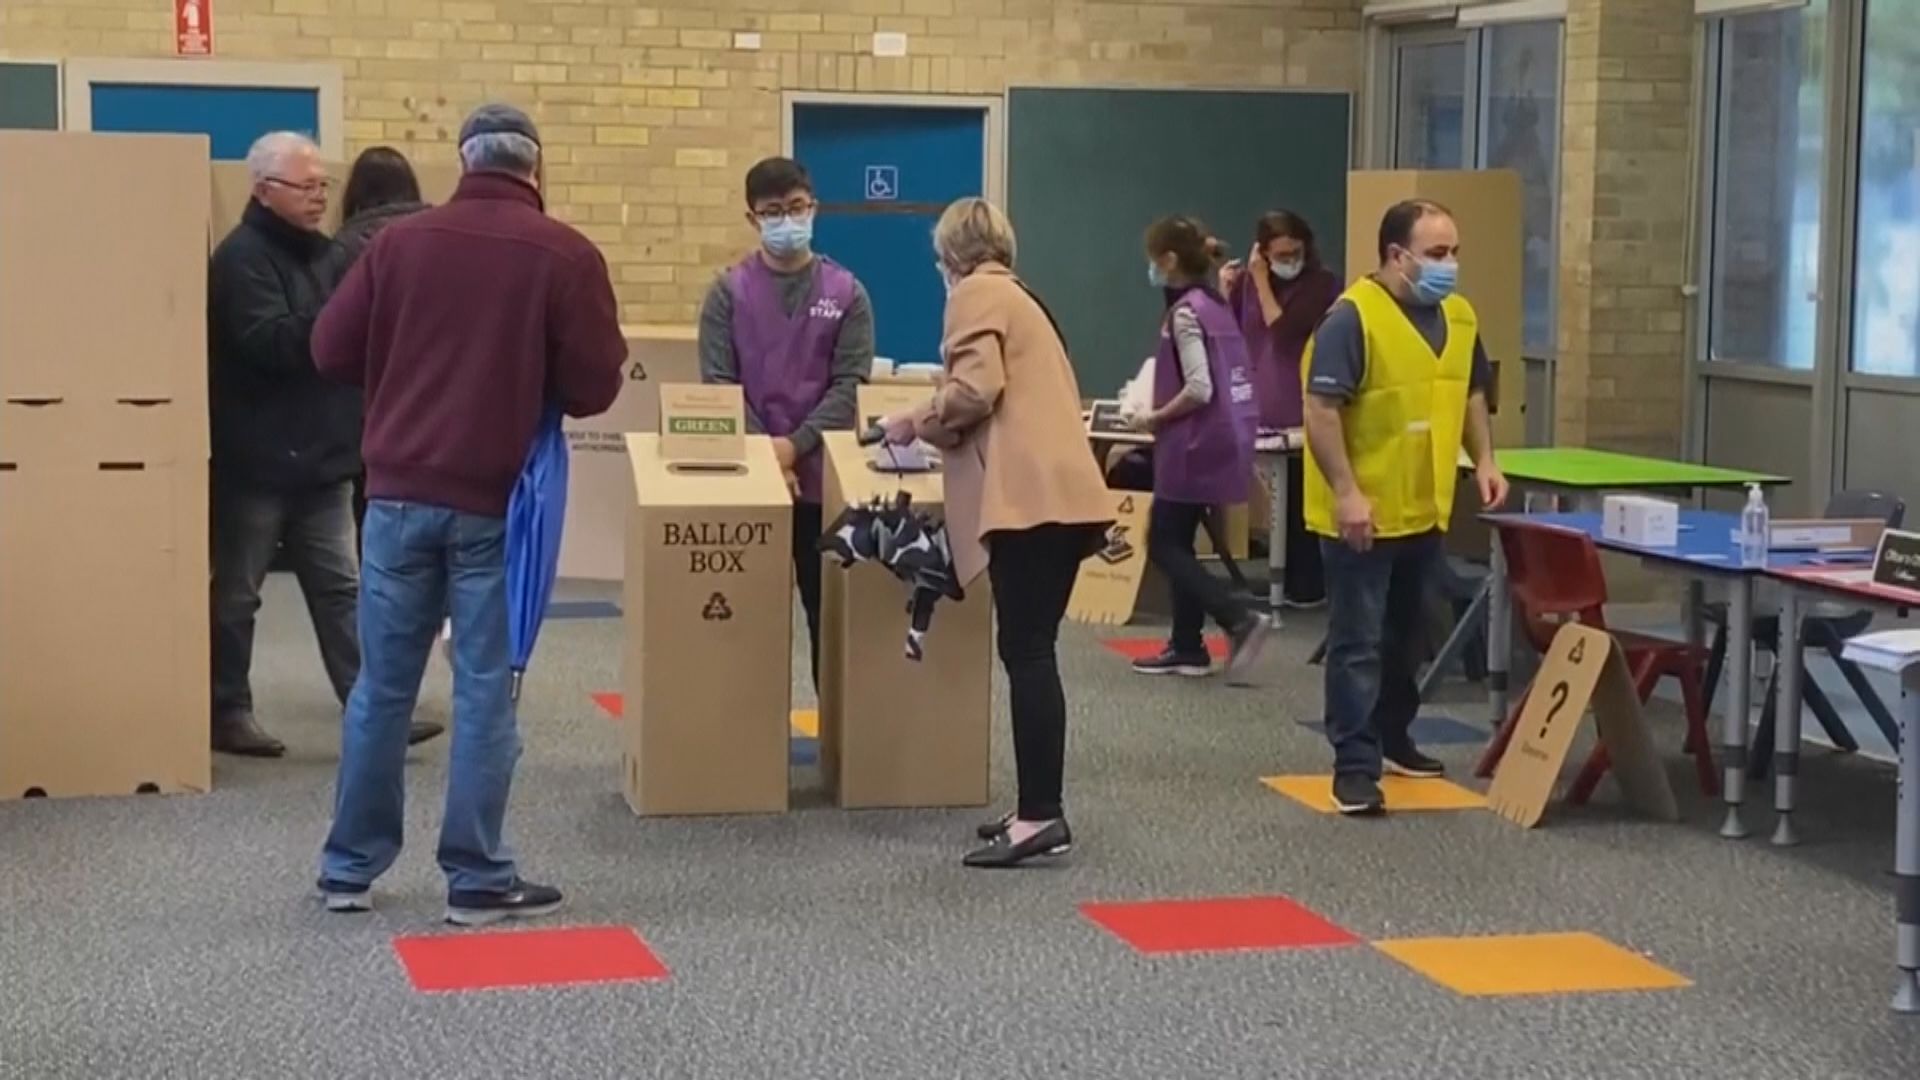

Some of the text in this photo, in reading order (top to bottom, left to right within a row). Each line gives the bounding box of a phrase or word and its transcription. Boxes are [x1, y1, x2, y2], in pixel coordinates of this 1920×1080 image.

[809, 306, 844, 320] STAFF
[675, 418, 731, 433] GREEN
[663, 523, 772, 546] BALLOT
[690, 550, 745, 574] BOX
